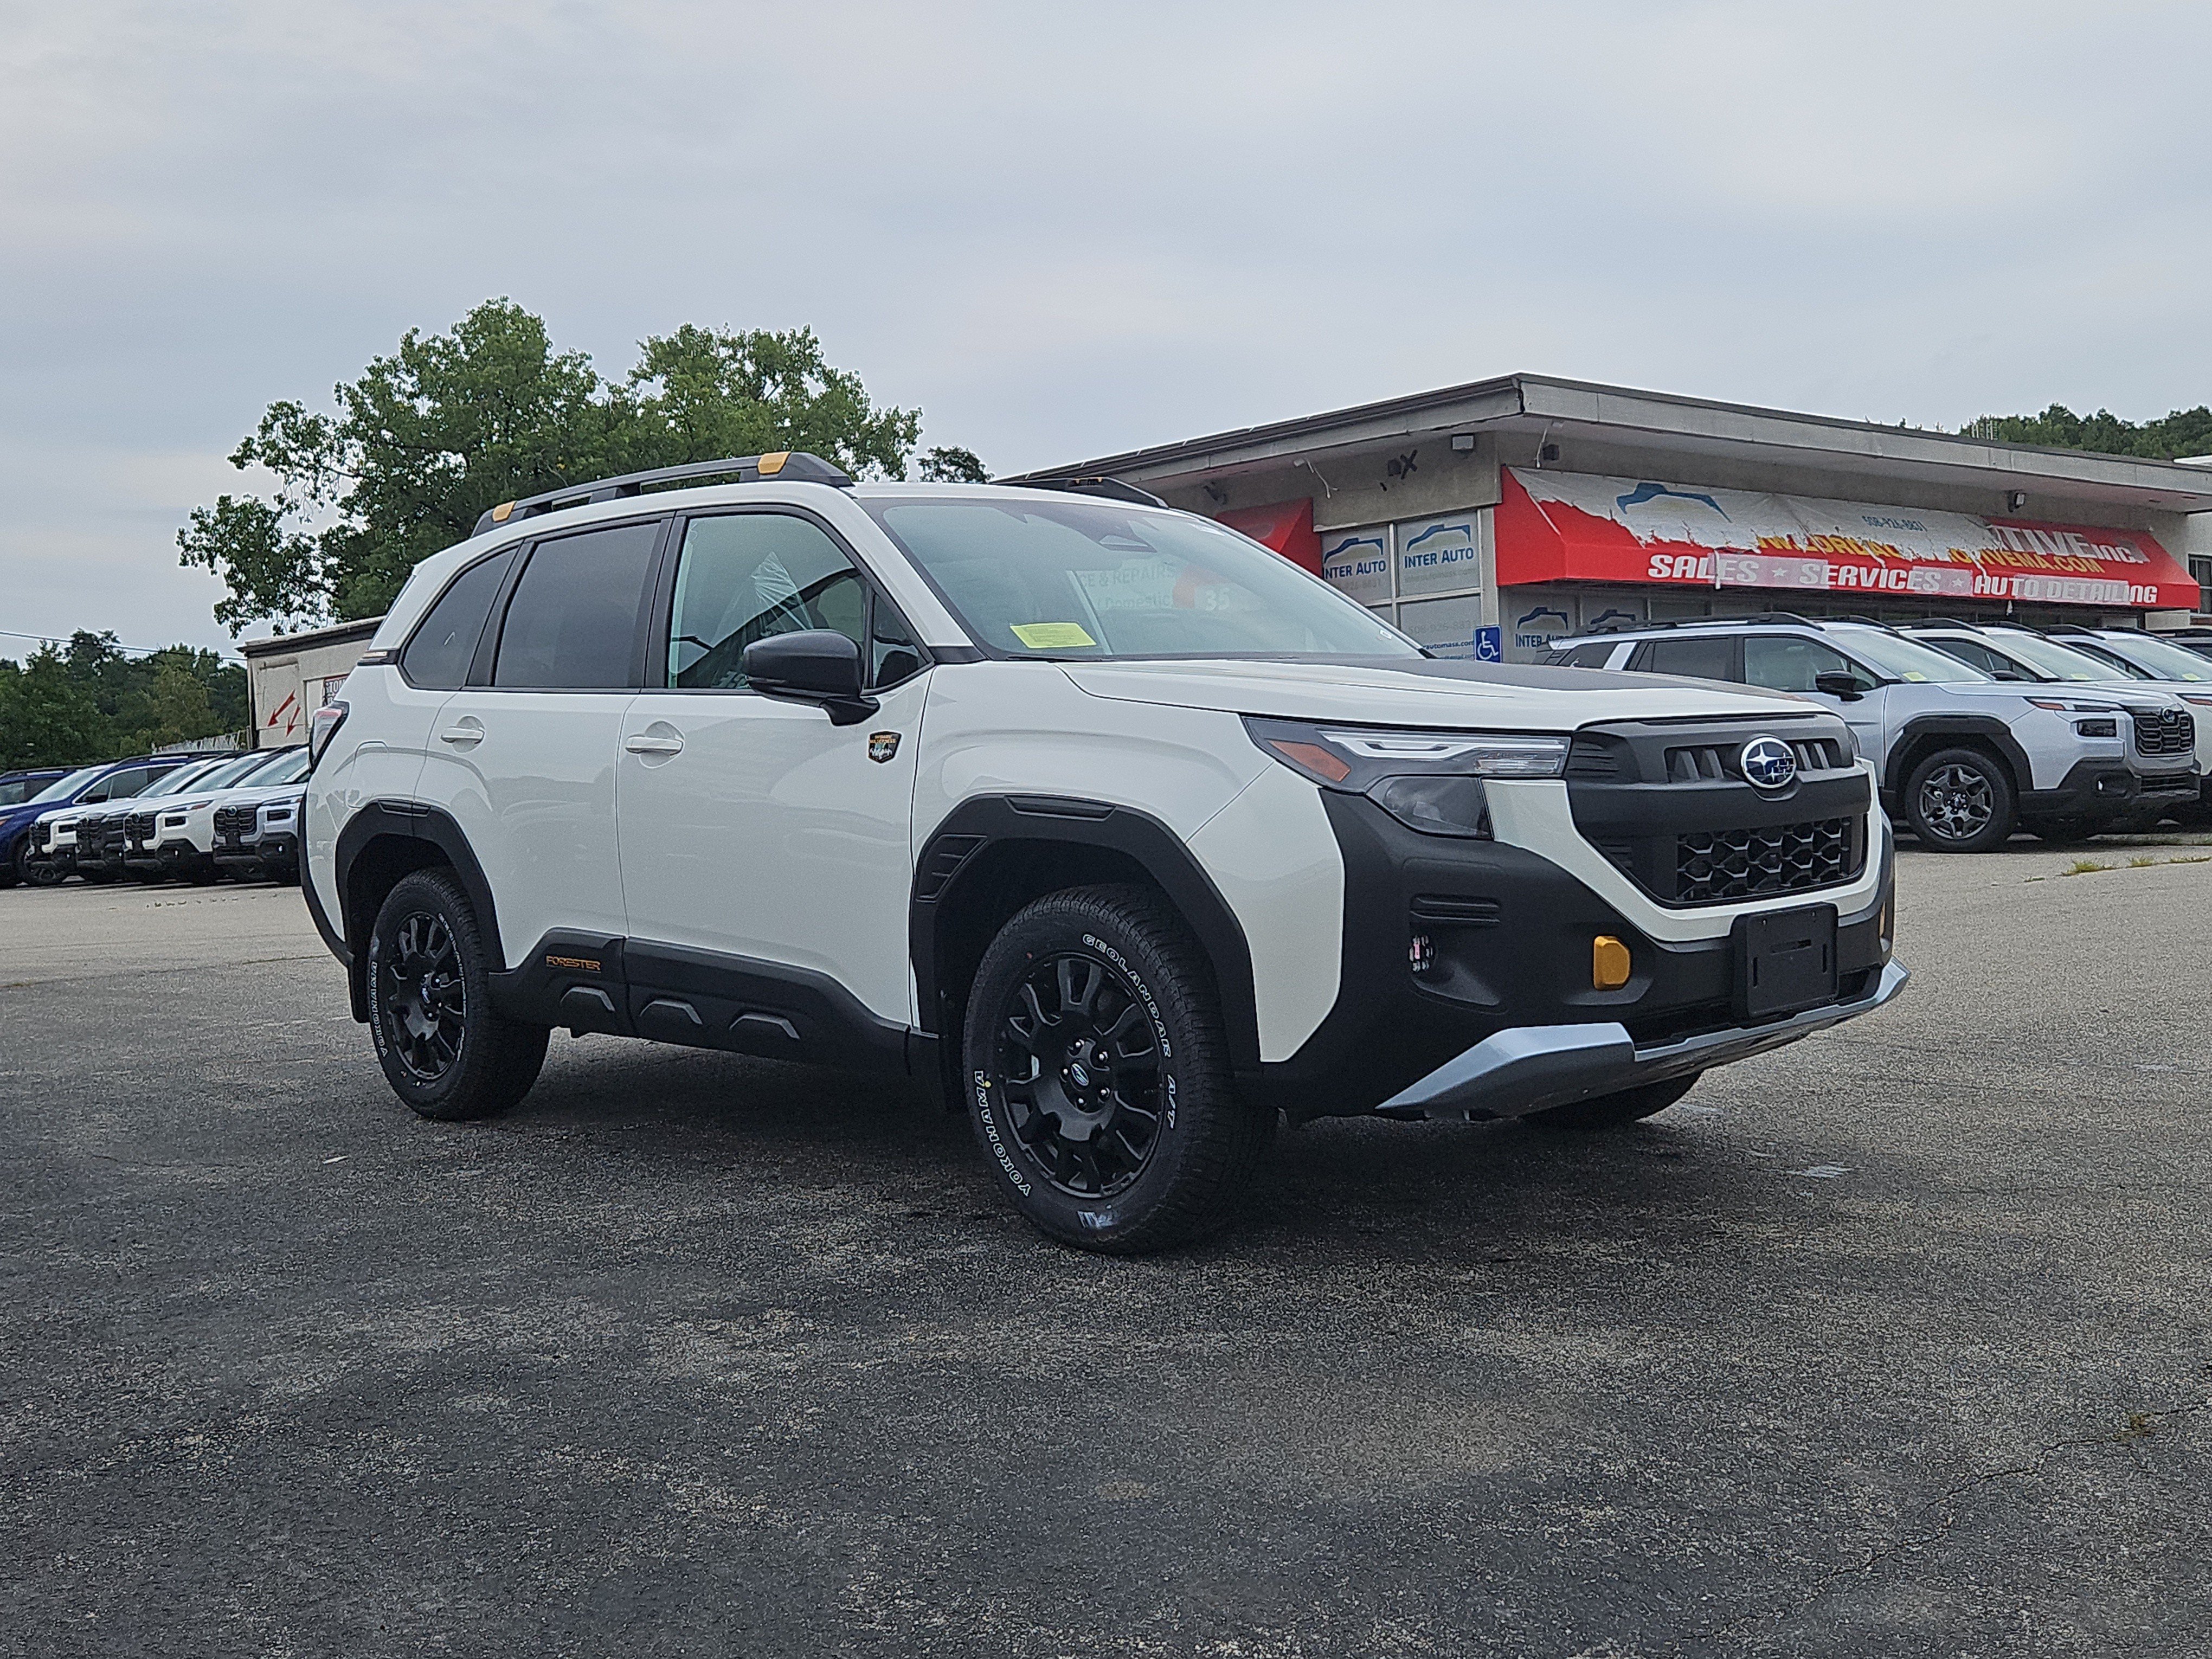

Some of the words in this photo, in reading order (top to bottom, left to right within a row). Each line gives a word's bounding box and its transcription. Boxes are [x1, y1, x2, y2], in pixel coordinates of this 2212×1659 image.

[1356, 561, 1386, 575] AUTO
[1405, 553, 1437, 569] INTER
[1441, 547, 1474, 564] AUTO
[1648, 555, 1759, 582] SALES
[1799, 563, 1942, 592] SERVICES
[1974, 575, 2040, 596] AUTO
[2046, 579, 2158, 604] DETAILING
[546, 955, 601, 970] FORESTER
[1083, 934, 1172, 1058] GEOLANDAR
[974, 1070, 1031, 1197] YOKOHAMA
